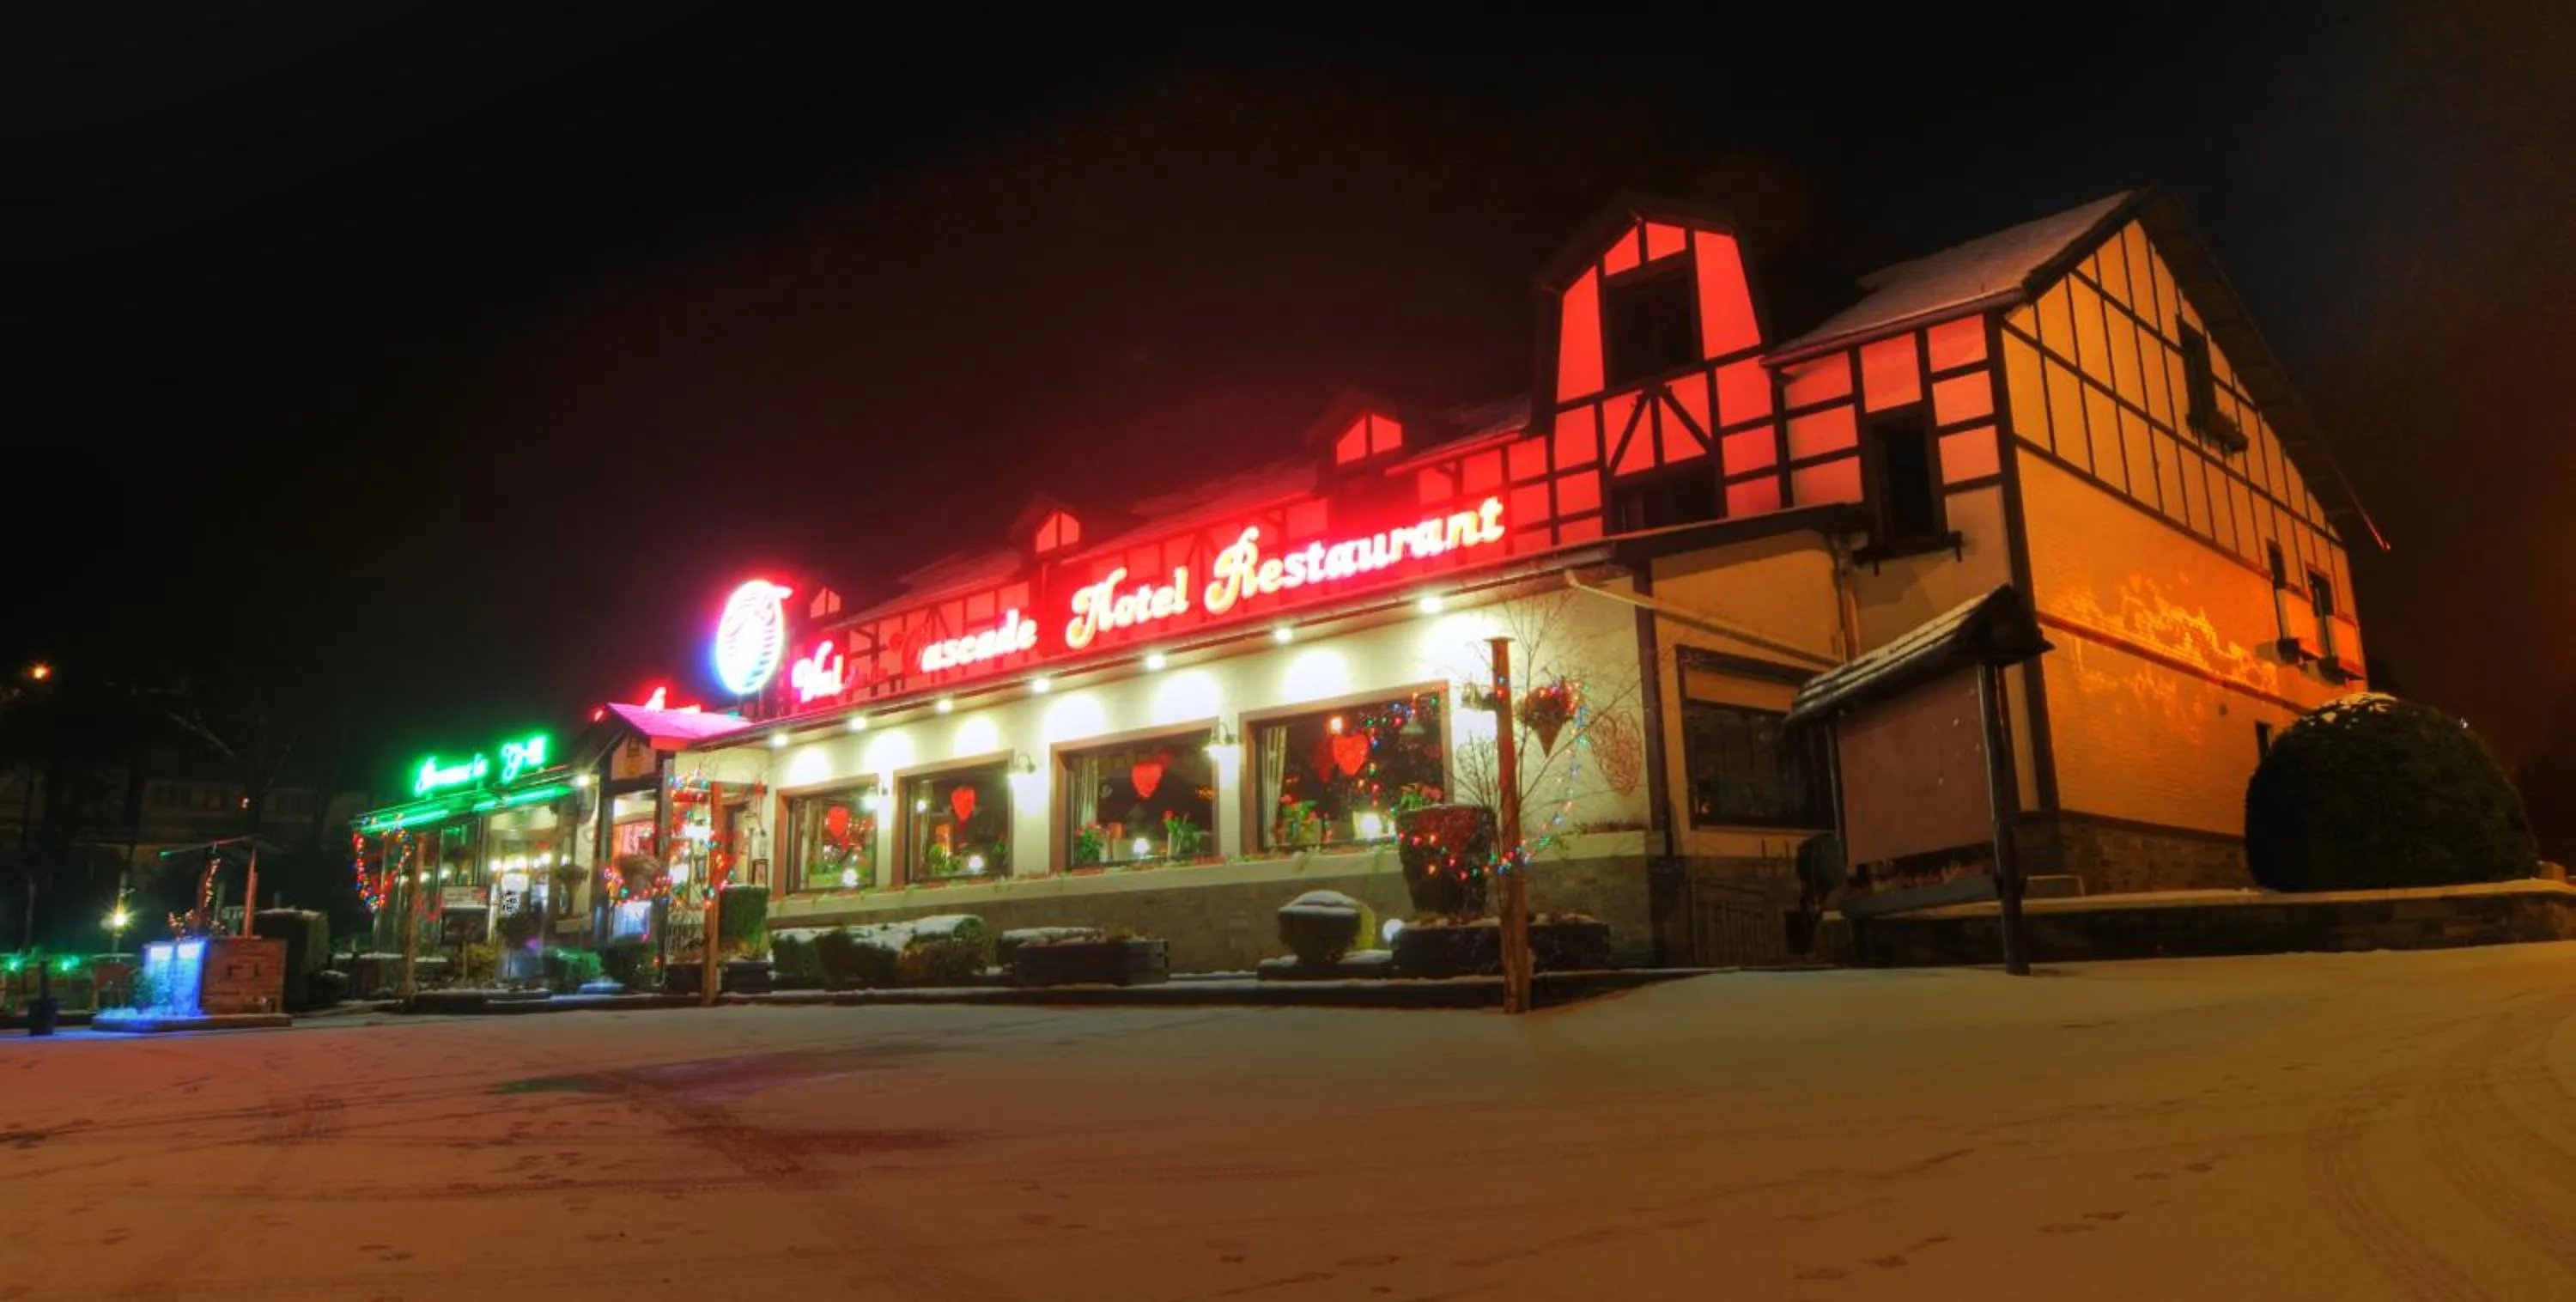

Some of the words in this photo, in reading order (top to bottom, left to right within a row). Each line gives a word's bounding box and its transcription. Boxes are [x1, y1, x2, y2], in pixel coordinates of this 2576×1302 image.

[790, 640, 845, 703] Val
[1065, 565, 1189, 650] Hotel
[1204, 496, 1505, 613] Restaurant
